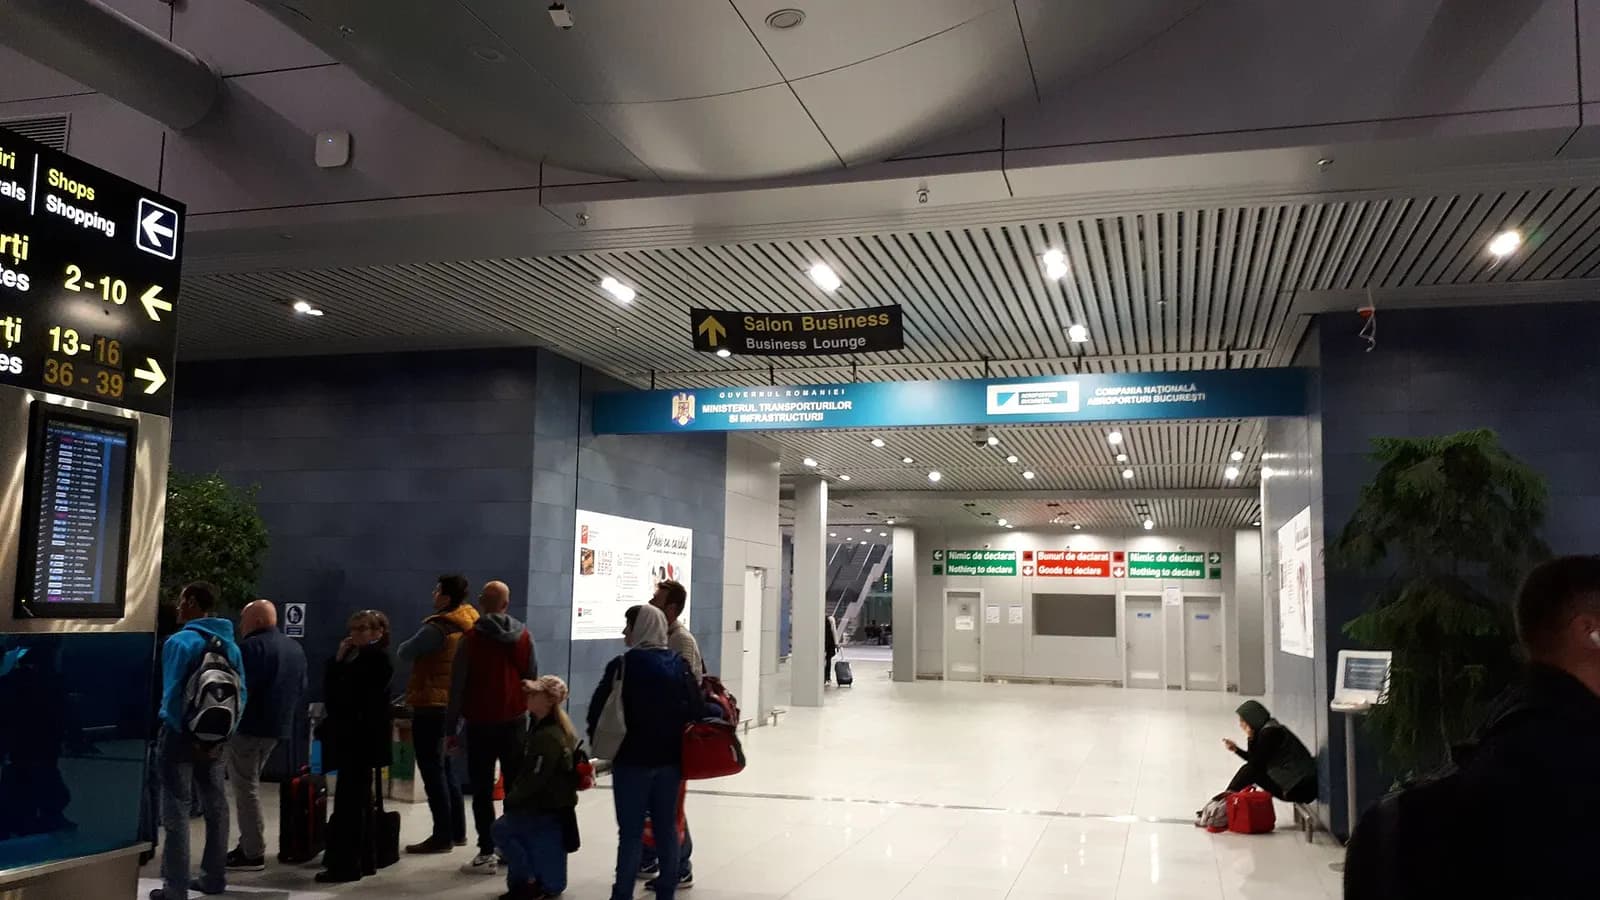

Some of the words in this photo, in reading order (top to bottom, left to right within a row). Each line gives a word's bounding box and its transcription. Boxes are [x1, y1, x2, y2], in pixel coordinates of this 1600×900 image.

[48, 168, 95, 201] Shops
[46, 194, 115, 238] Shopping
[743, 316, 793, 332] Salon
[802, 313, 889, 332] Business
[746, 338, 807, 350] Business
[813, 337, 866, 350] Lounge
[719, 391, 780, 399] GUVERNUL
[1095, 386, 1143, 396] COMPANIA
[702, 403, 757, 413] MINISTERUL
[759, 401, 853, 412] TRANSPORTURILOR
[1087, 396, 1152, 407] AEROPORTURI
[740, 412, 824, 423] INFRASTRUCTURII
[948, 551, 971, 560] Nimic
[972, 551, 982, 560] de
[983, 551, 1016, 560] declarat
[1038, 551, 1065, 560] Bunuri
[1065, 552, 1076, 561] de
[1076, 551, 1109, 561] declarat
[1129, 552, 1155, 562] Nimic
[1156, 553, 1167, 562] de
[1168, 553, 1203, 563] declarat
[948, 565, 976, 575] Nothing
[977, 566, 985, 574] to
[986, 565, 1013, 574] declare
[1038, 565, 1064, 574] Goods
[1064, 566, 1073, 575] to
[1073, 566, 1102, 575] declare
[1129, 567, 1160, 577] Nothing
[1161, 568, 1170, 577] to
[1171, 567, 1201, 577] declare
